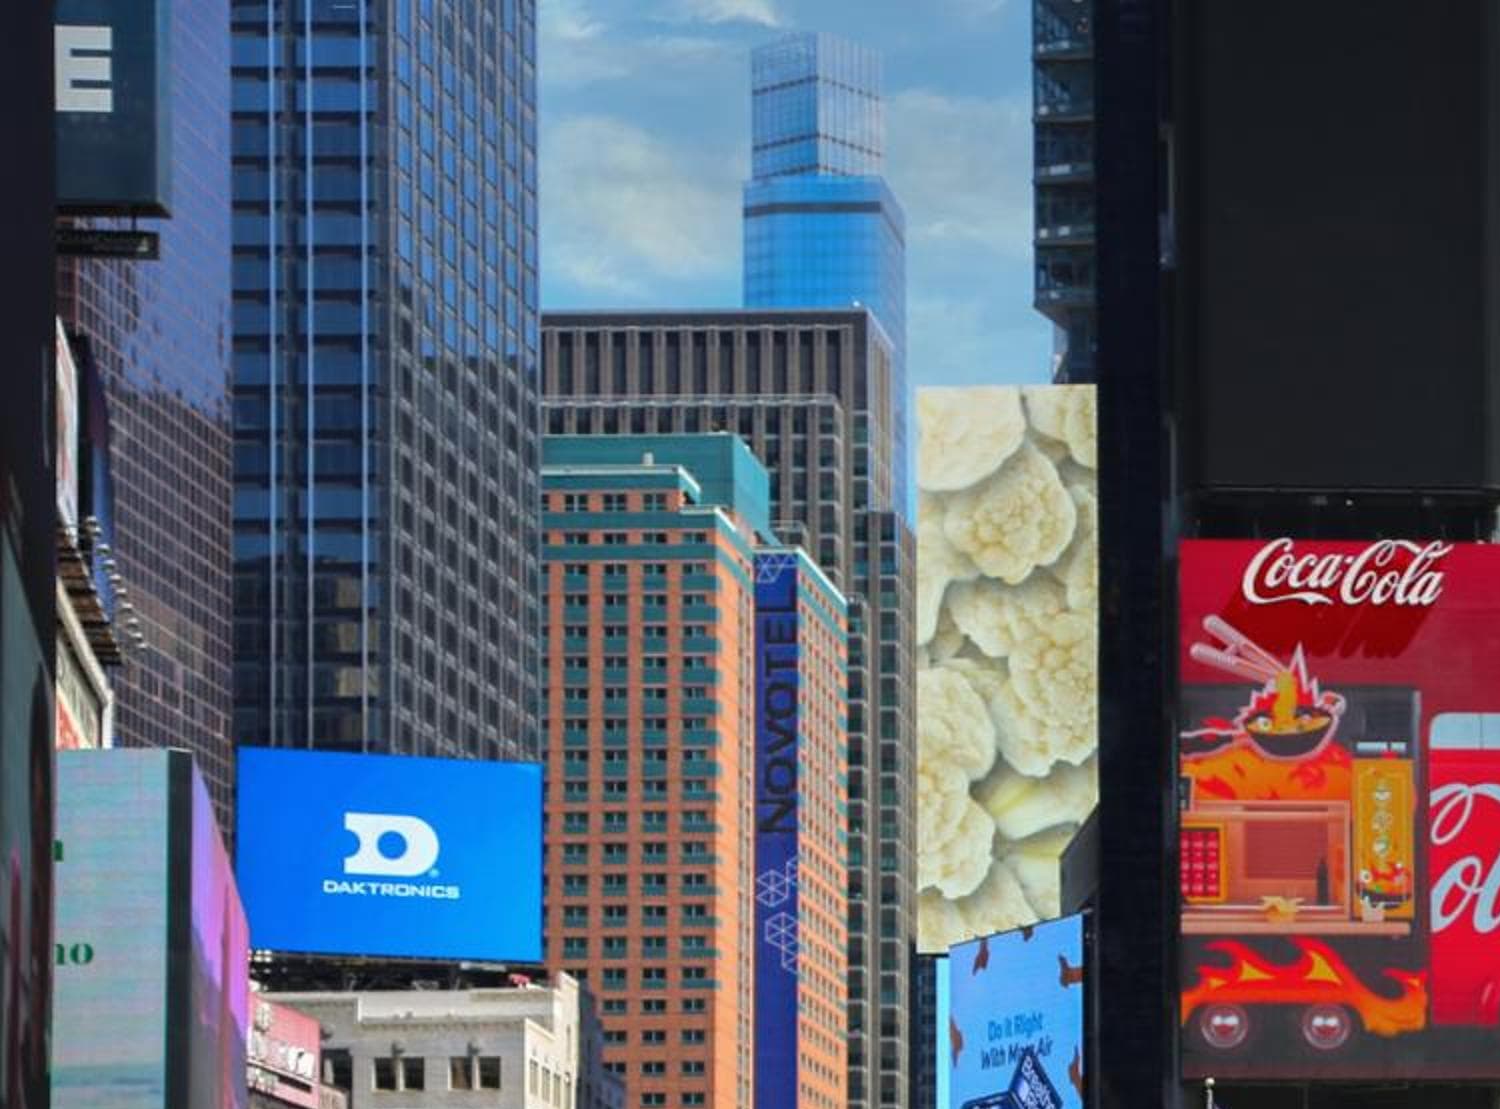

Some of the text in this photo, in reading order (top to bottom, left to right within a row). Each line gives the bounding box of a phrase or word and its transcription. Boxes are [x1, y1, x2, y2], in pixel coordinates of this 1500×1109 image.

[1242, 537, 1454, 606] Coca-Cola
[755, 582, 798, 834] NOVOTEL
[323, 879, 461, 900] DAKTRONICS
